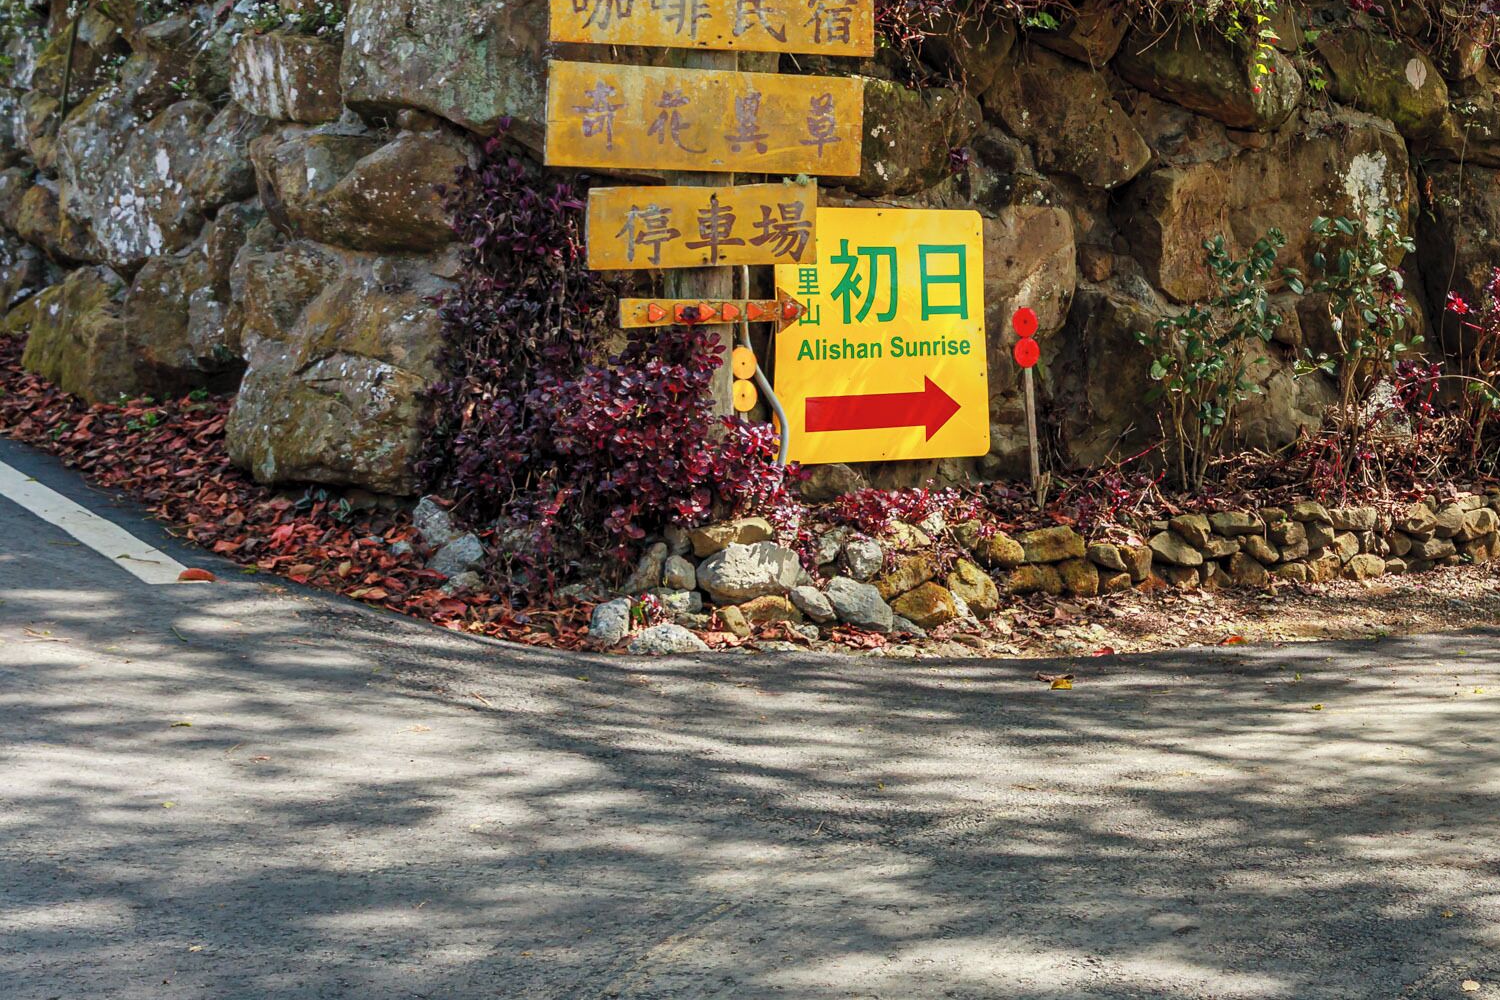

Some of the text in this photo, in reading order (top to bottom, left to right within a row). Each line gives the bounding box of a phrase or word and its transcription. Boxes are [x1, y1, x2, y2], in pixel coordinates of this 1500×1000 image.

[571, 80, 843, 158] 奇花異草
[615, 199, 813, 265] 停車場
[796, 266, 821, 327] 里山
[830, 238, 969, 325] 初日
[797, 335, 971, 361] Alishan Sunrise
